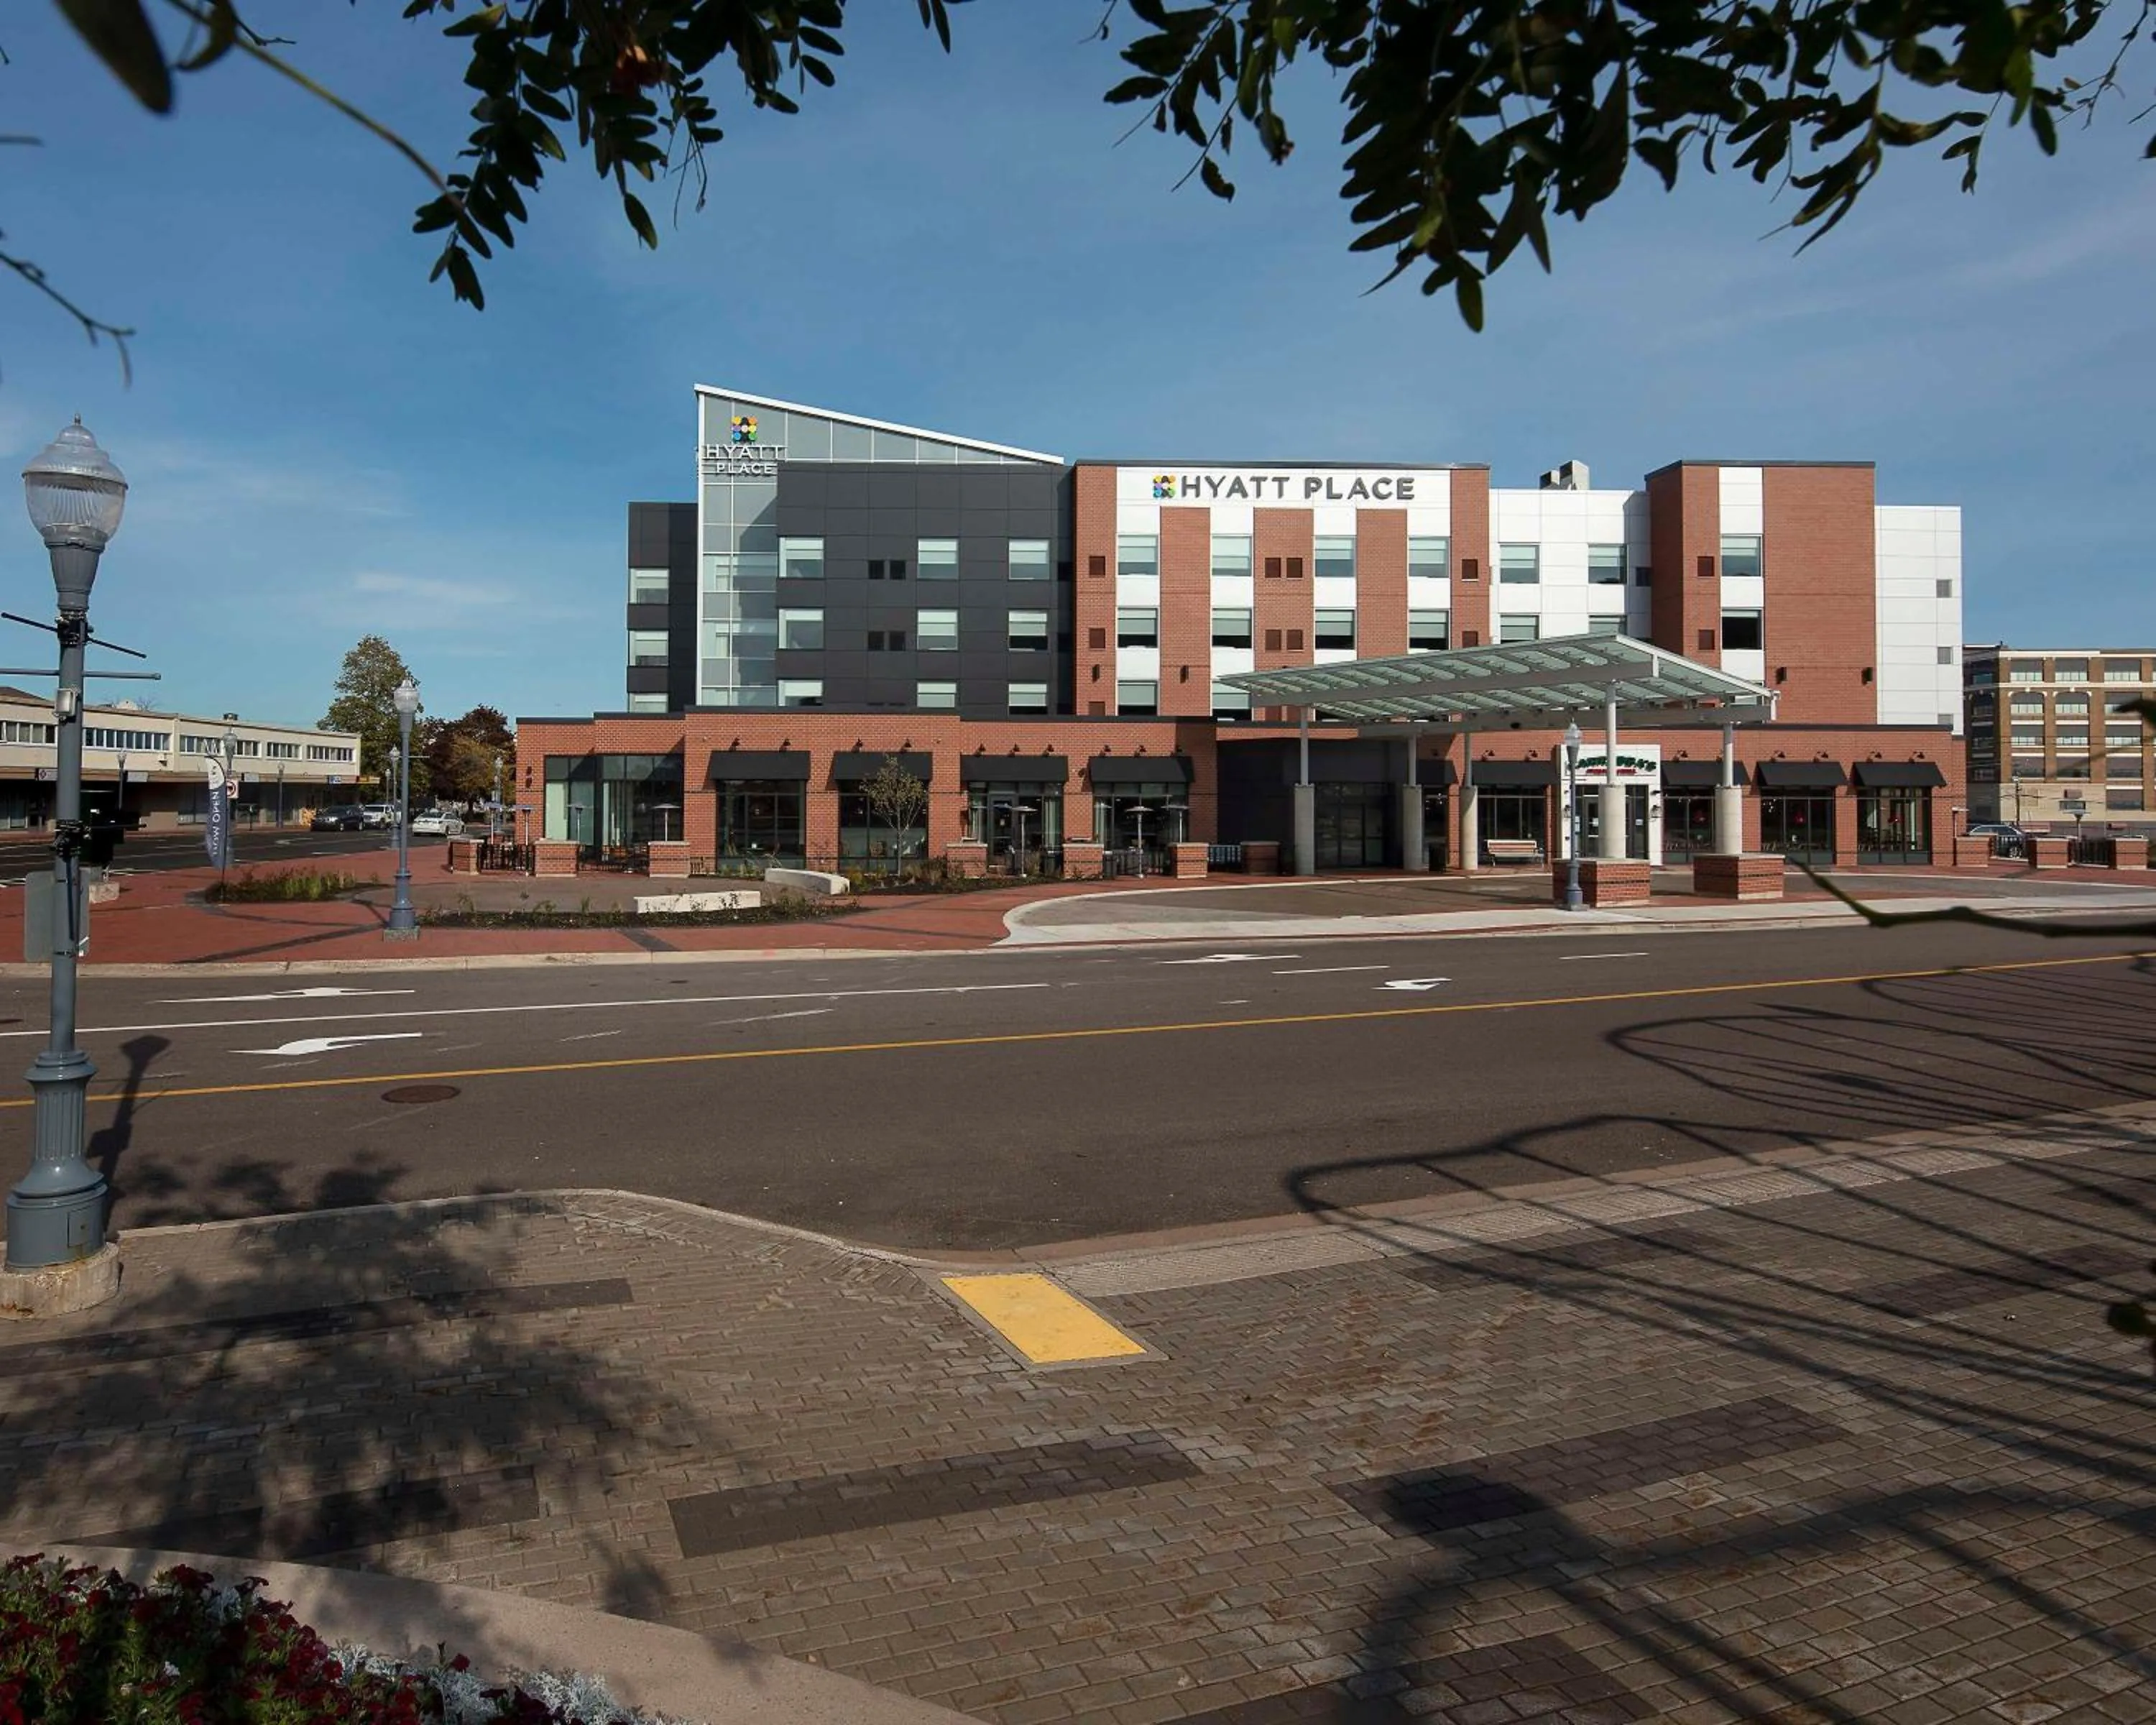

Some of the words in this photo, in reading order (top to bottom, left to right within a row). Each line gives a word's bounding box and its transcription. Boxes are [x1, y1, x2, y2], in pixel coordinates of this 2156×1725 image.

[706, 443, 786, 459] HYATT
[717, 462, 773, 474] PLACE
[1181, 475, 1290, 498] HYATT
[1304, 477, 1416, 500] PLACE
[212, 791, 221, 823] OPEN
